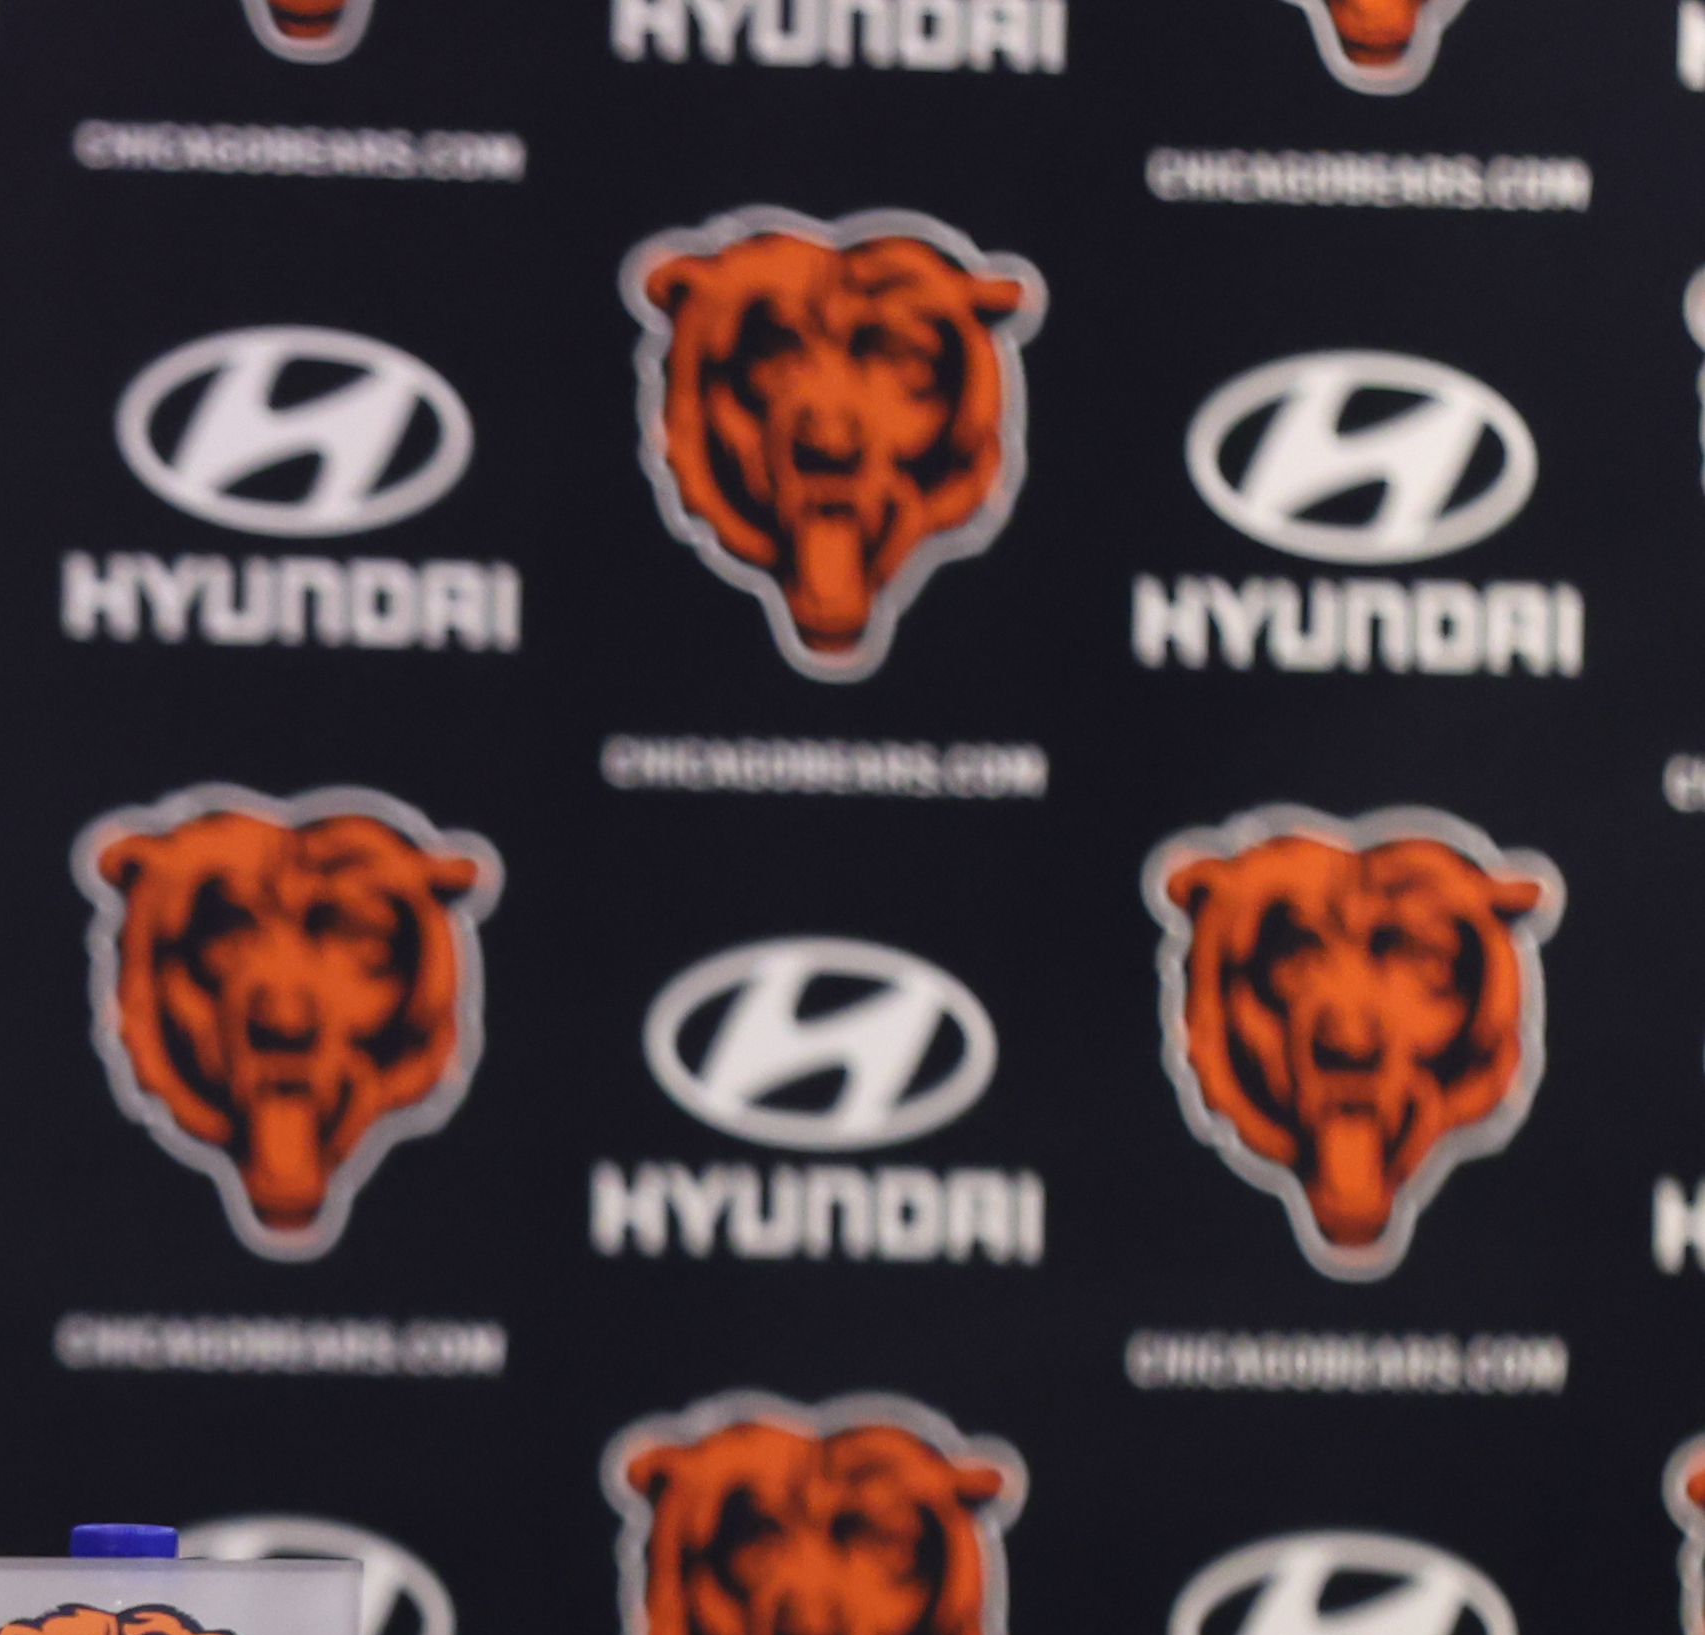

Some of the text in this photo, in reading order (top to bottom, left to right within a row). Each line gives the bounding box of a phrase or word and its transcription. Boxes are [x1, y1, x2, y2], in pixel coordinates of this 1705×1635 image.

[62, 553, 520, 649] HYUNDAI
[1133, 582, 1584, 675] HYUNDAI
[591, 1165, 1044, 1262] HYUNDAI
